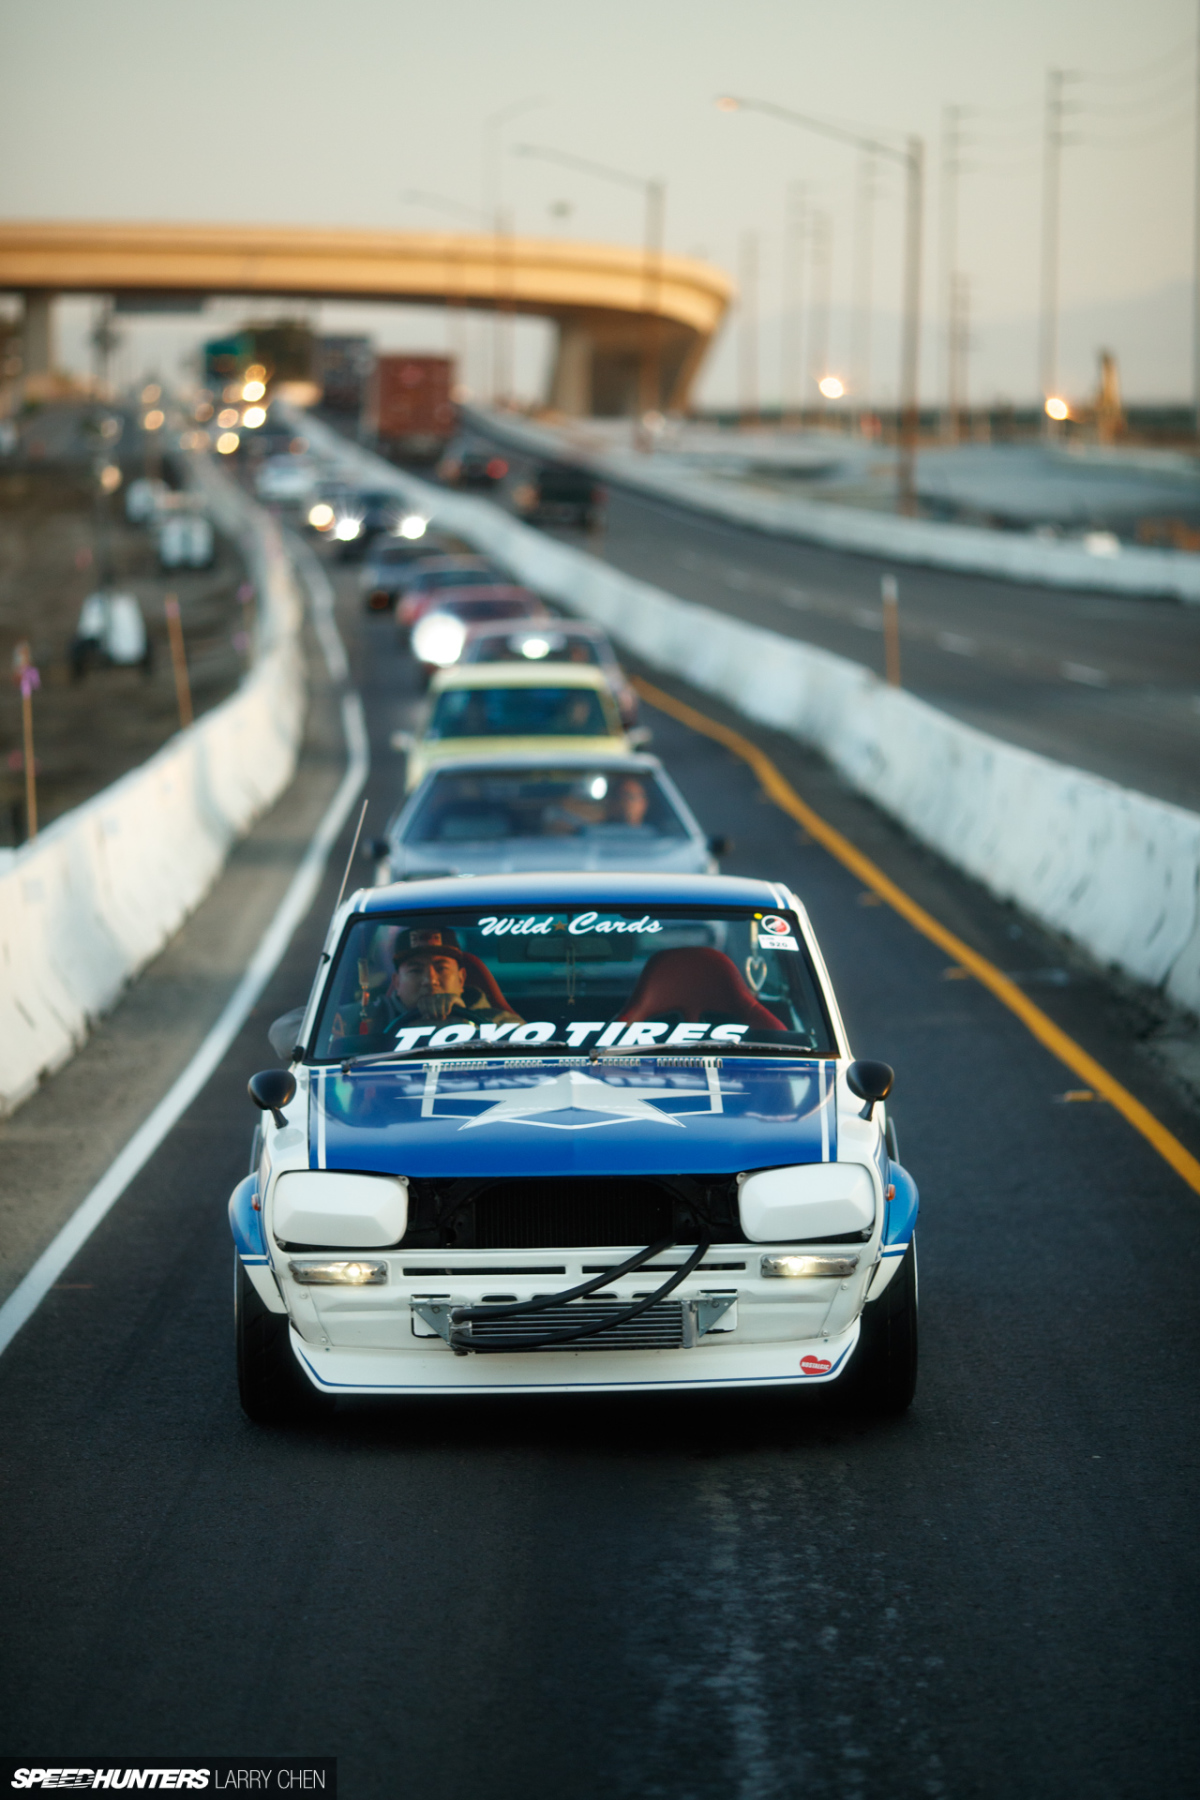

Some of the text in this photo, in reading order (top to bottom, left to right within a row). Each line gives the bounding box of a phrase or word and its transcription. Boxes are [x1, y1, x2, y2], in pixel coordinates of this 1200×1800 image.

[478, 911, 663, 936] Wild Cards
[394, 1021, 750, 1052] TOYO TIRES
